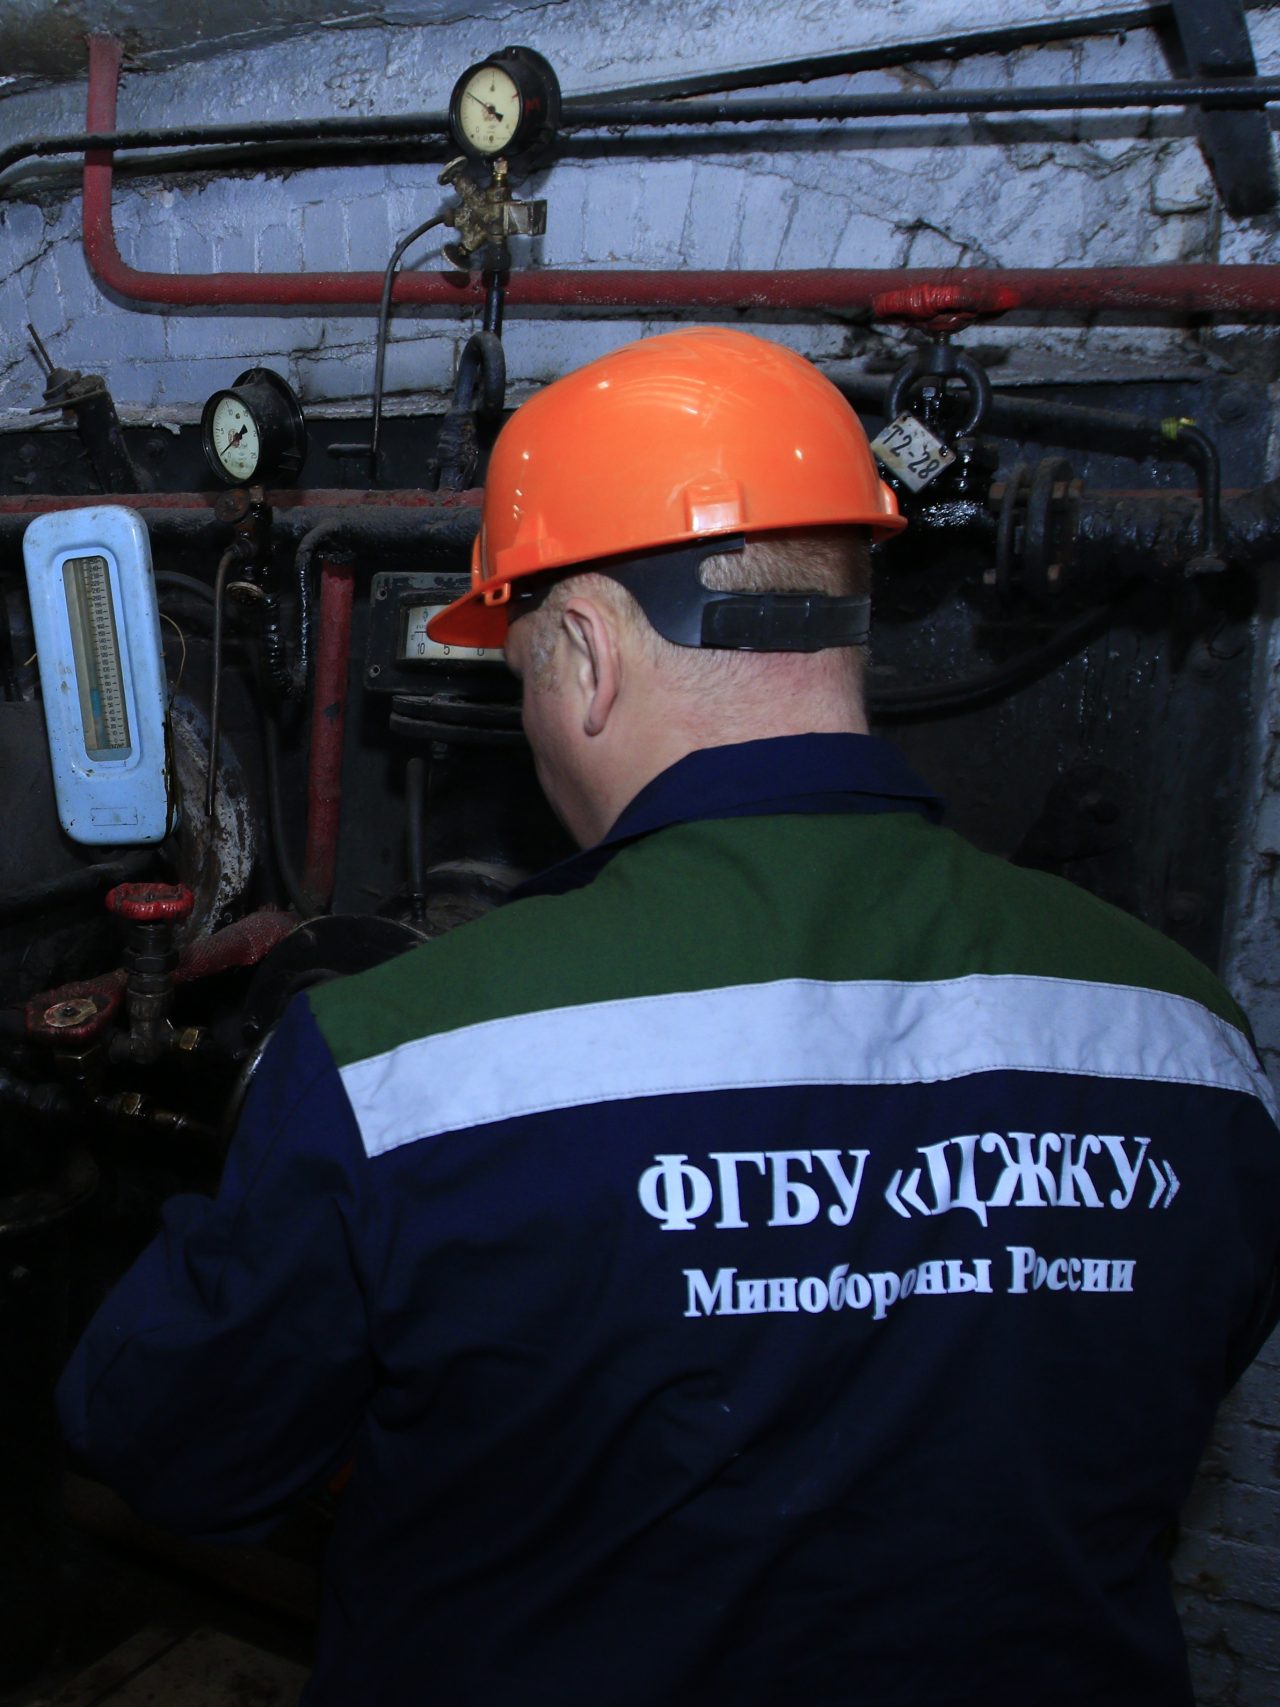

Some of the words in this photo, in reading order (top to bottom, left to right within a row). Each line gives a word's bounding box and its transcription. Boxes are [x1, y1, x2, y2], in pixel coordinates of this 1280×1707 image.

[638, 1149, 870, 1231] ФГБУ
[885, 1132, 1181, 1228] «ЦЖКУ»
[683, 1258, 994, 1320] Минобороны
[1006, 1246, 1137, 1294] России
